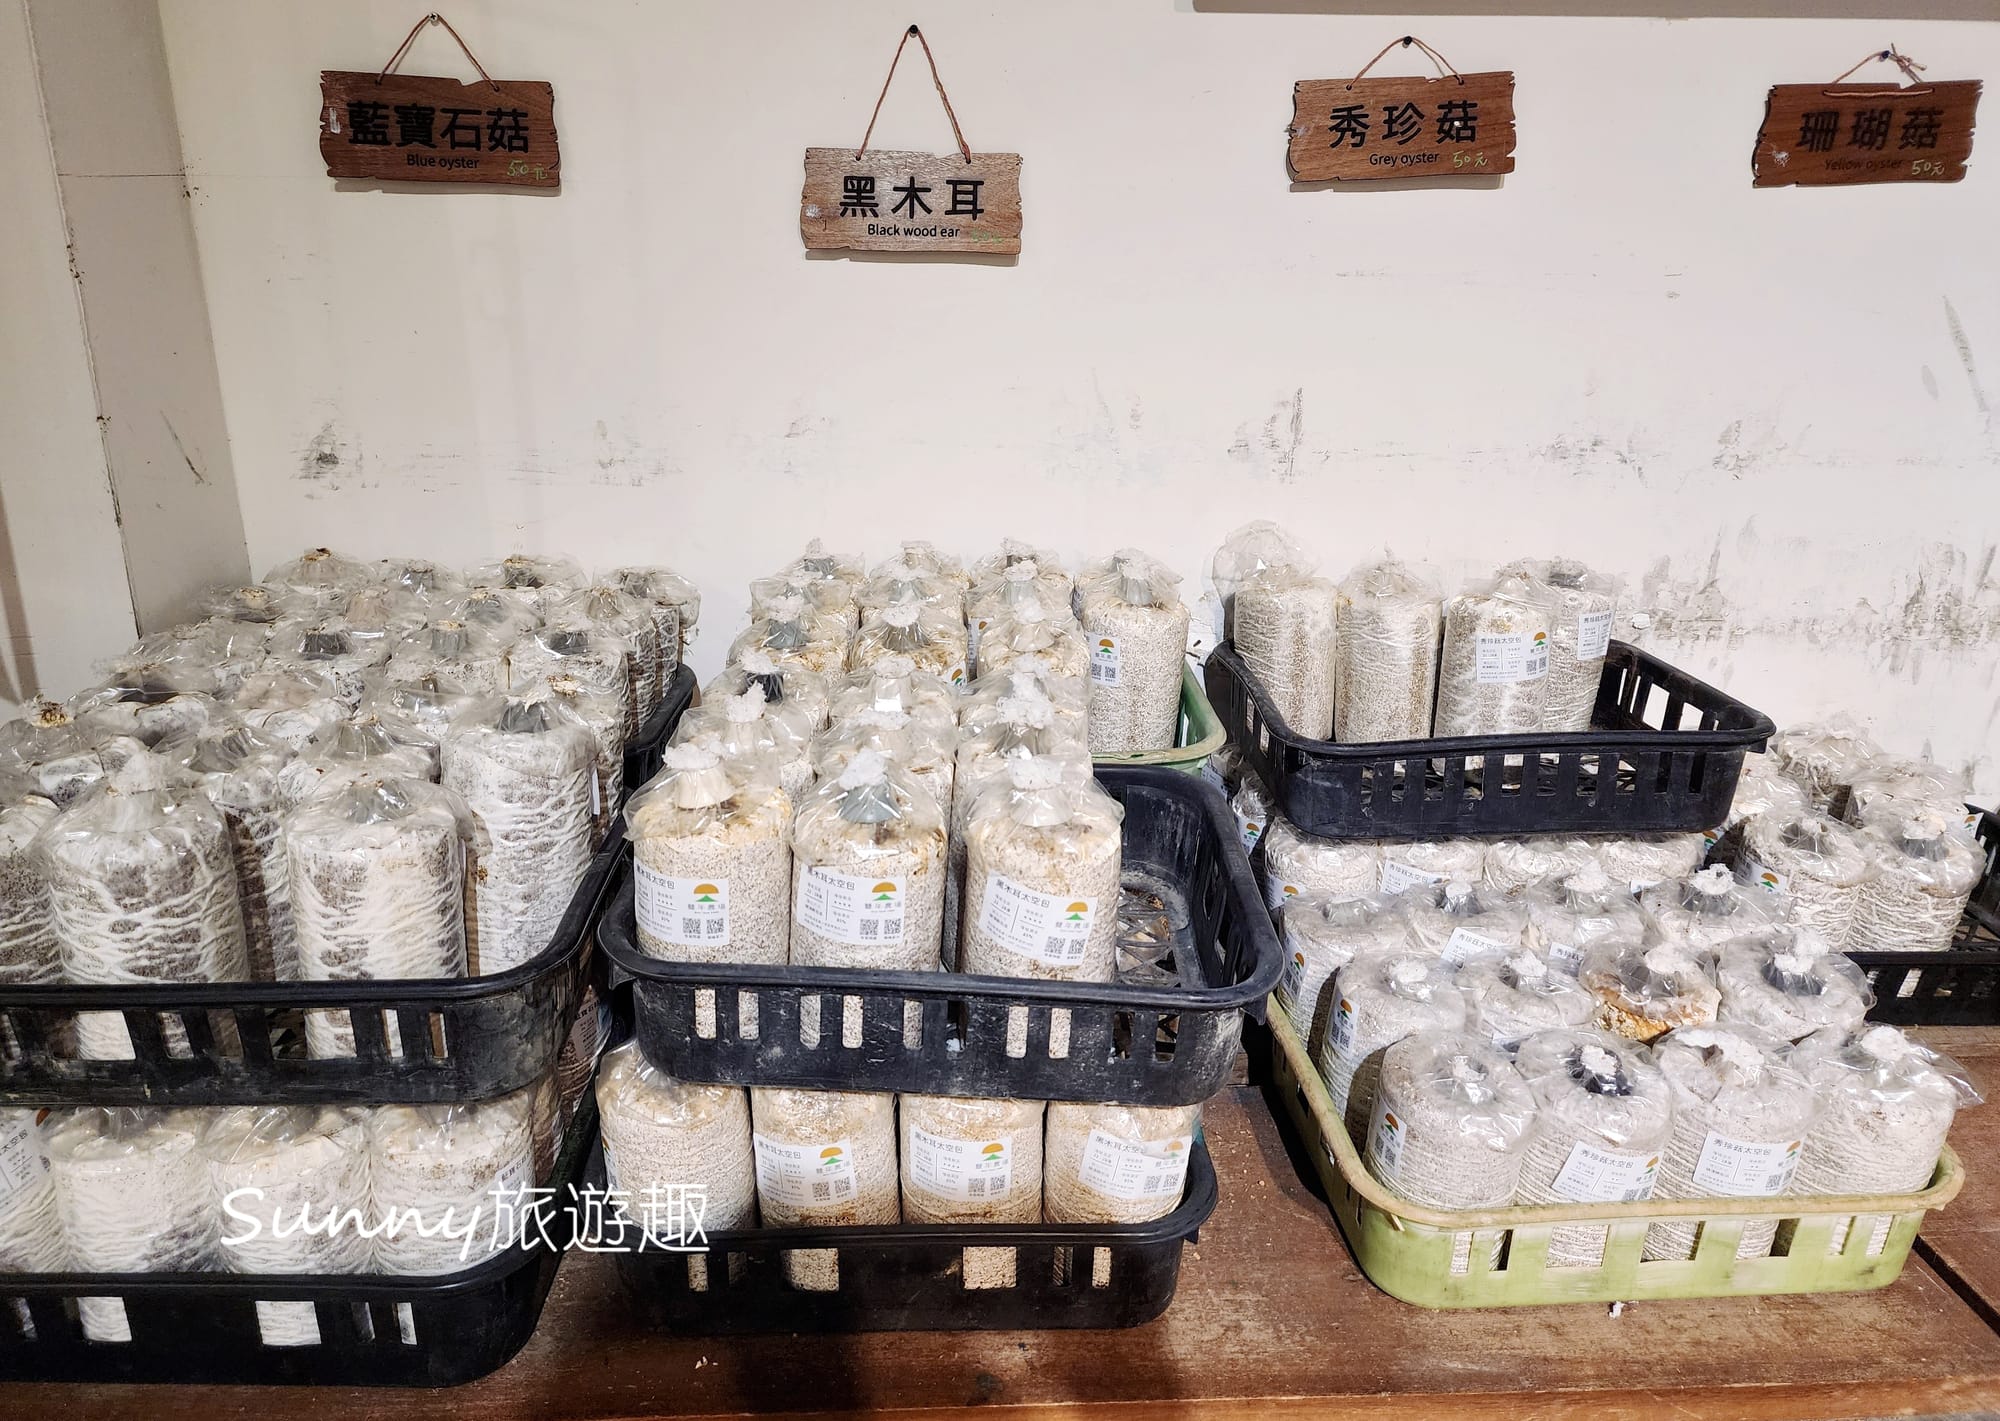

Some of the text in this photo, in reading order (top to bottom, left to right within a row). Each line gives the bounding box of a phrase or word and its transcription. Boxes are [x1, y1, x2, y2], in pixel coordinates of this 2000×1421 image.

[346, 100, 529, 154] 藍寶石菇
[1328, 100, 1479, 149] 秀珍菇
[1796, 108, 1944, 153] 珊瑚菇
[406, 153, 480, 170] Blue oyster
[1369, 152, 1441, 169] Grey oyster
[1824, 158, 1864, 171] Yellow
[839, 175, 985, 221] 黑木耳
[867, 223, 900, 237] Black
[903, 224, 937, 238] wood
[940, 226, 961, 238] ear
